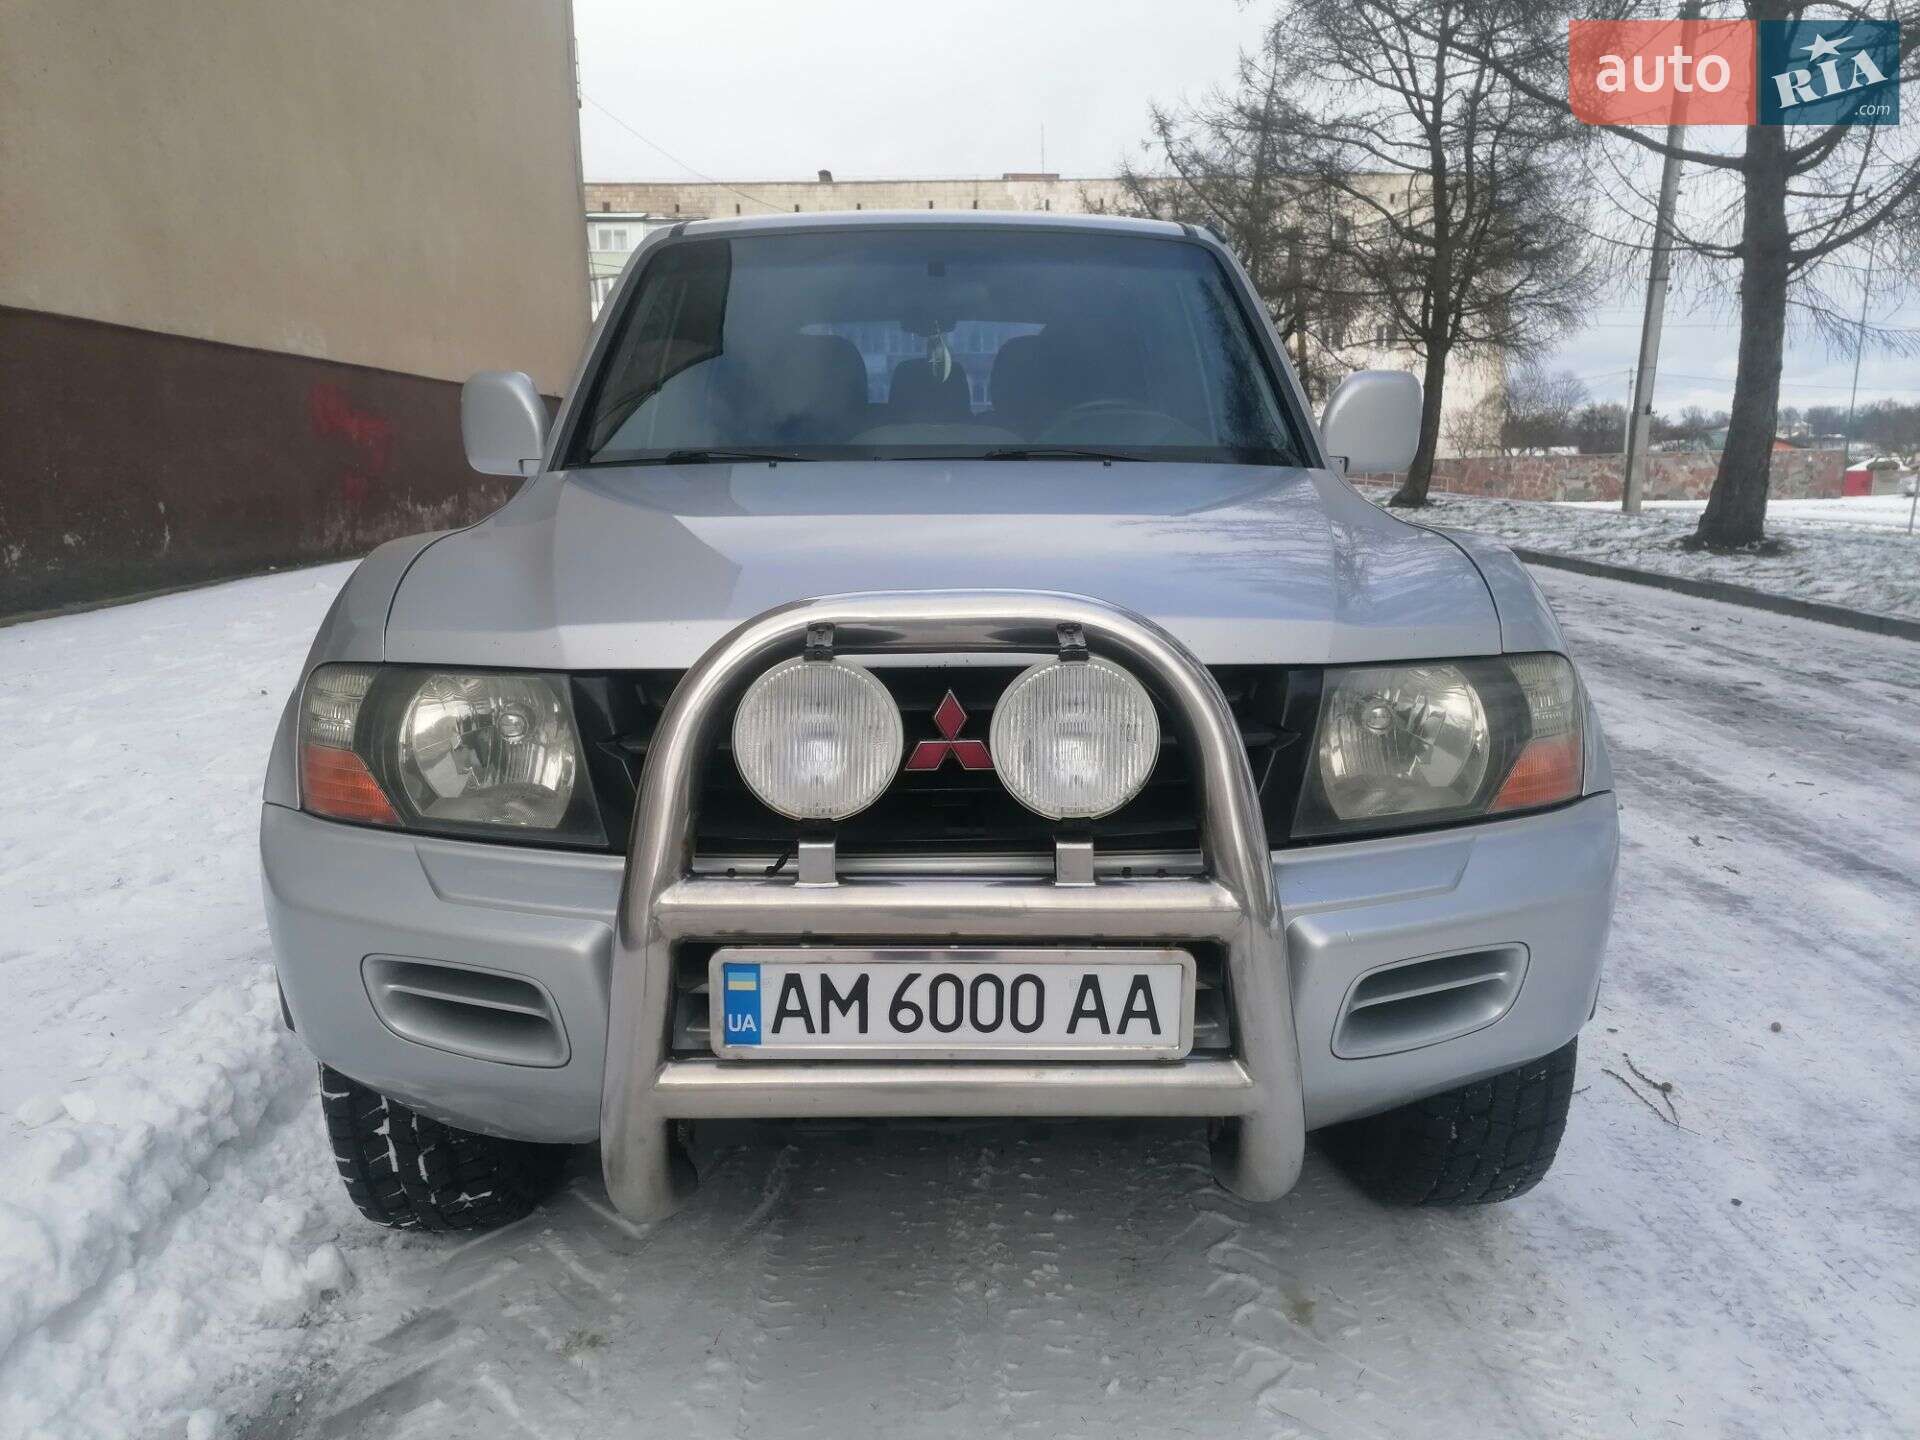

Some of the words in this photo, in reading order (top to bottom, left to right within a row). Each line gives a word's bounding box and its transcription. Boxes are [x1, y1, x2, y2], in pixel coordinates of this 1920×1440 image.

[728, 1013, 757, 1033] UA
[771, 972, 870, 1034] AM
[888, 972, 1045, 1034] 6000
[1066, 973, 1162, 1035] AA
